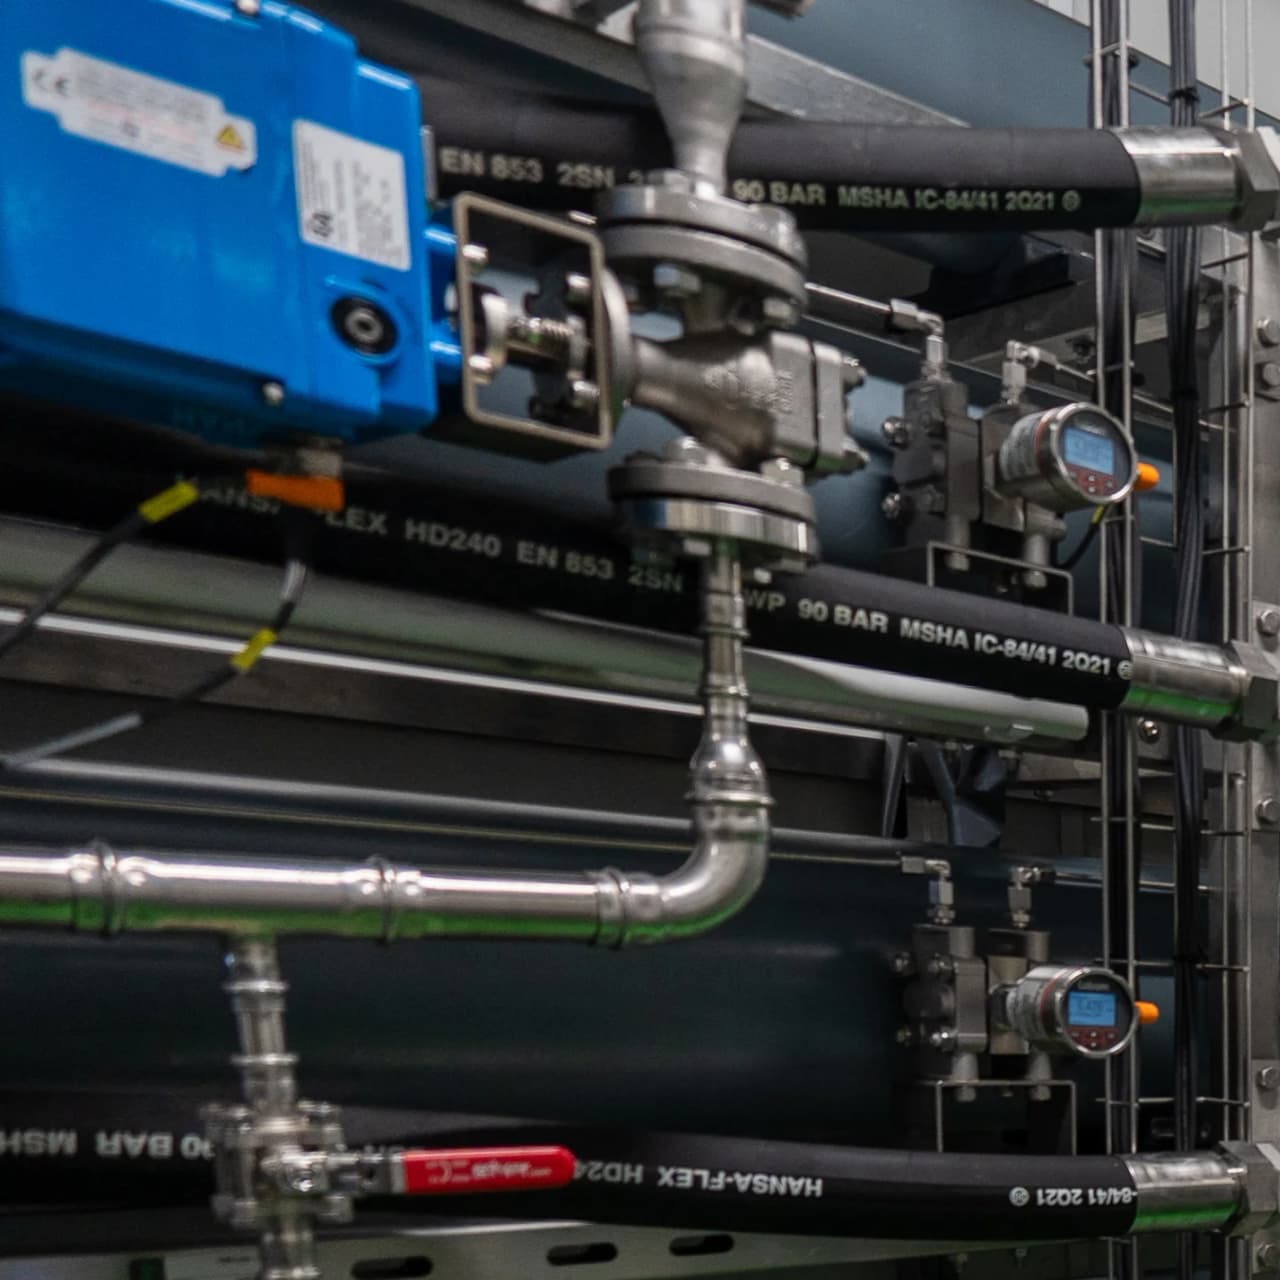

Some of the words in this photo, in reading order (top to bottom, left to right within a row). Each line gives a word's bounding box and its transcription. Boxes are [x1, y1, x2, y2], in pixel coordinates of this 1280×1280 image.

[440, 148, 485, 176] EN
[491, 155, 543, 183] 853
[556, 162, 615, 188] 2SN
[733, 178, 763, 202] 90
[770, 181, 826, 206] BAR
[838, 185, 909, 209] MSHA
[914, 189, 998, 210] IC-84/41
[1005, 190, 1055, 211] 2Q21
[405, 517, 502, 558] HD240
[516, 540, 560, 569] EN
[564, 550, 615, 580] 853
[627, 563, 685, 594] 2SN
[796, 598, 828, 623] 90
[833, 605, 889, 635] BAR
[899, 619, 969, 650] MSHA
[973, 633, 1058, 666] IC-84/41
[1062, 650, 1111, 675] 2Q21
[95, 1131, 173, 1160] BAR
[575, 1160, 644, 1185] HD24
[656, 1165, 823, 1198] HANSA-FLEX
[1036, 1187, 1083, 1207] 2Q21
